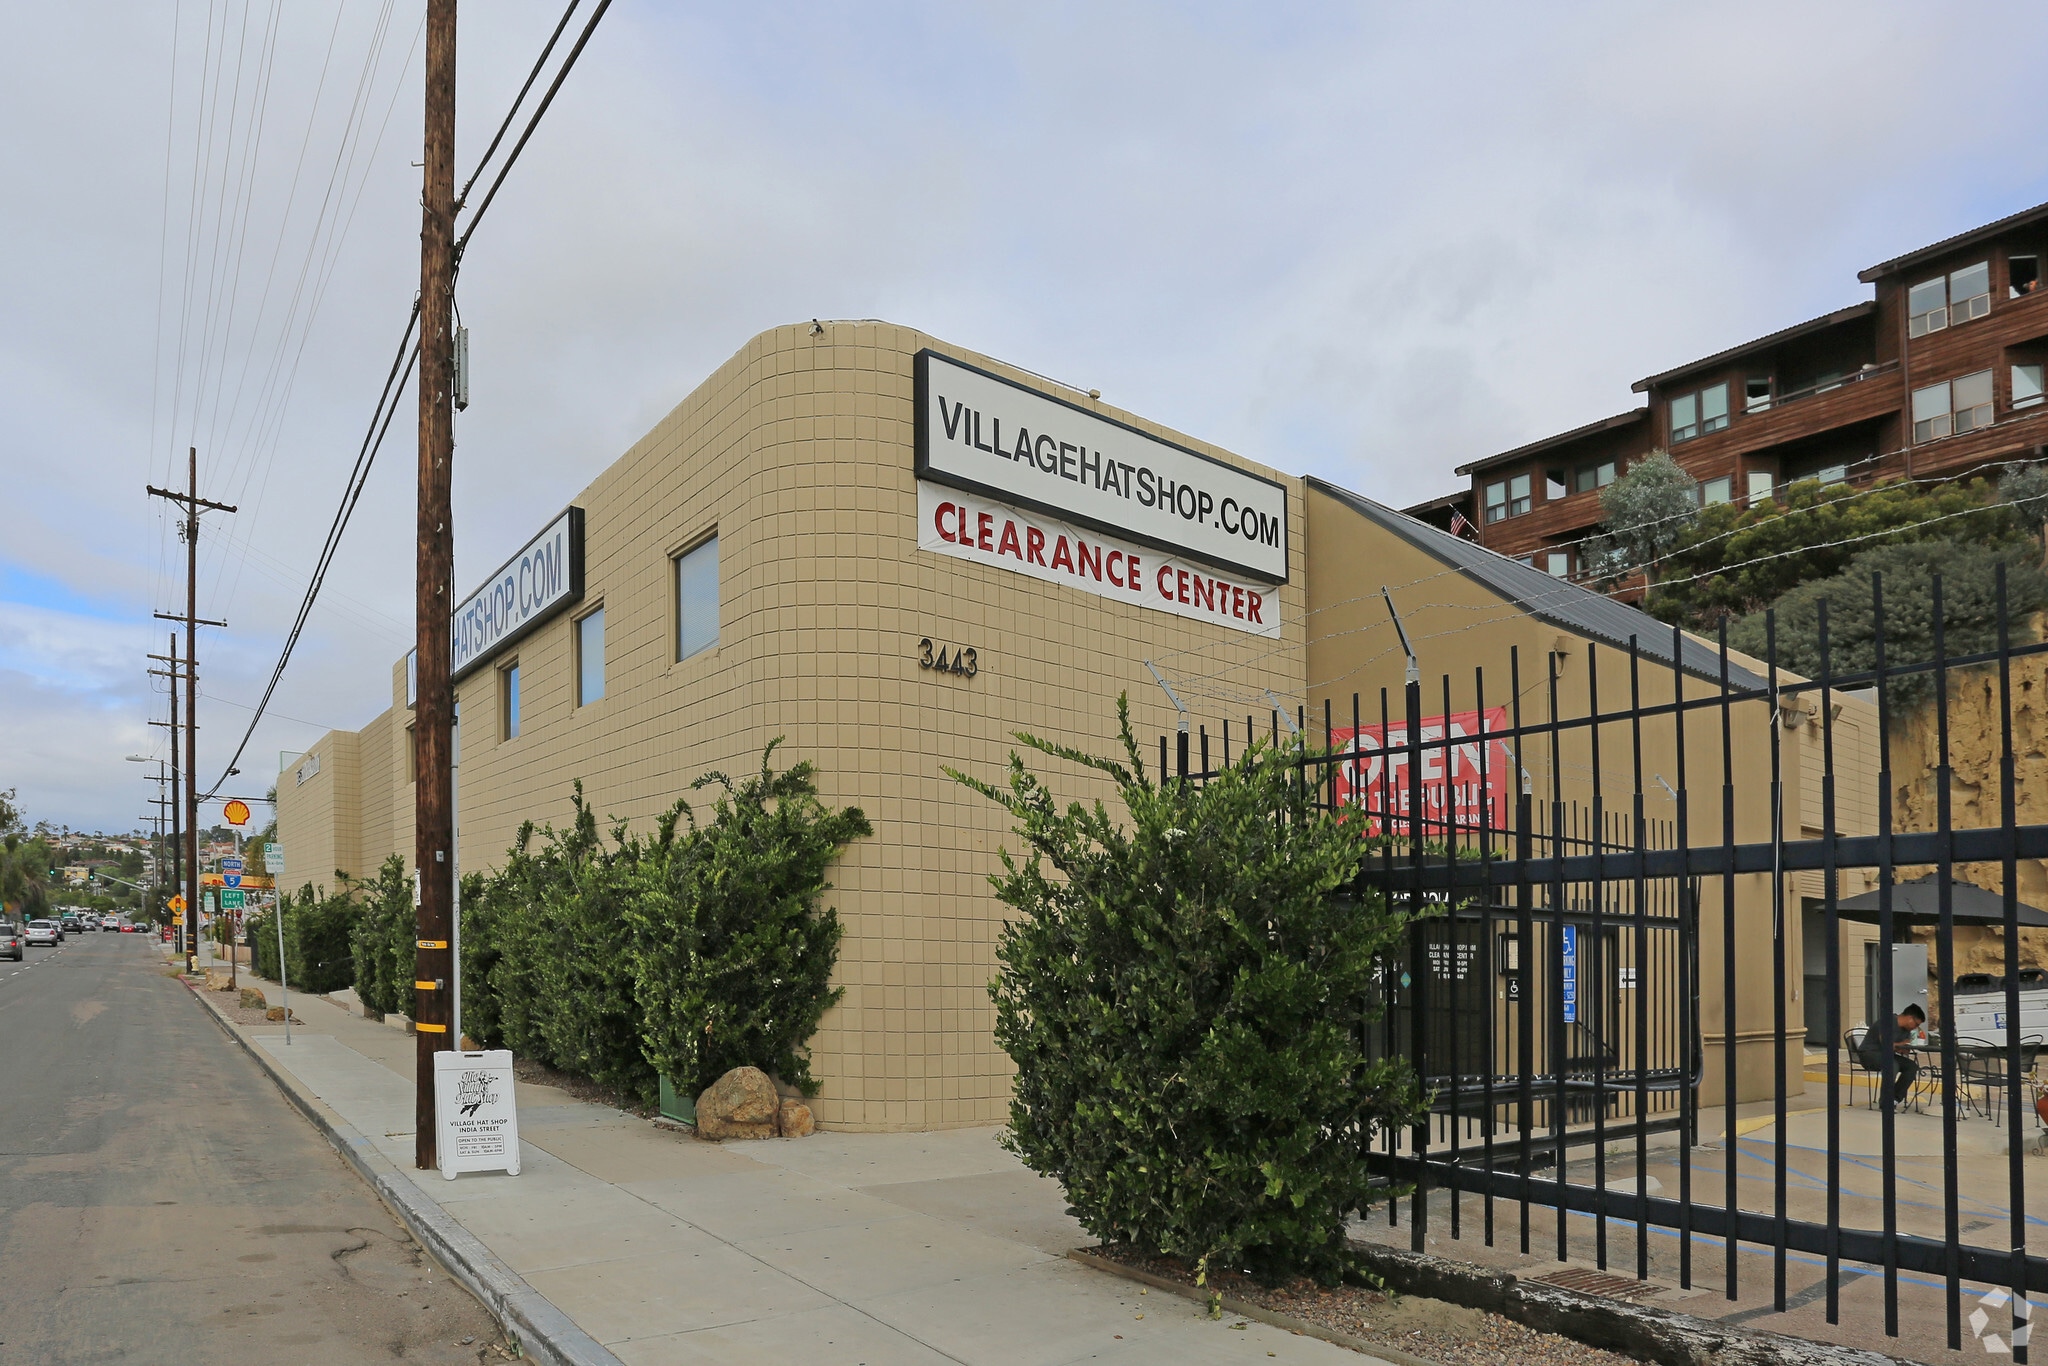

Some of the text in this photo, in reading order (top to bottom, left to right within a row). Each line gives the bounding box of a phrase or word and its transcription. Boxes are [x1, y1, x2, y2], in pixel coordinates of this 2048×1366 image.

[937, 395, 1280, 549] VILLAGEHATSHOP.COM
[934, 501, 1264, 625] CLEARANCE CENTER
[918, 637, 978, 678] 3443
[1341, 719, 1490, 788] OPEN
[230, 877, 235, 885] 5
